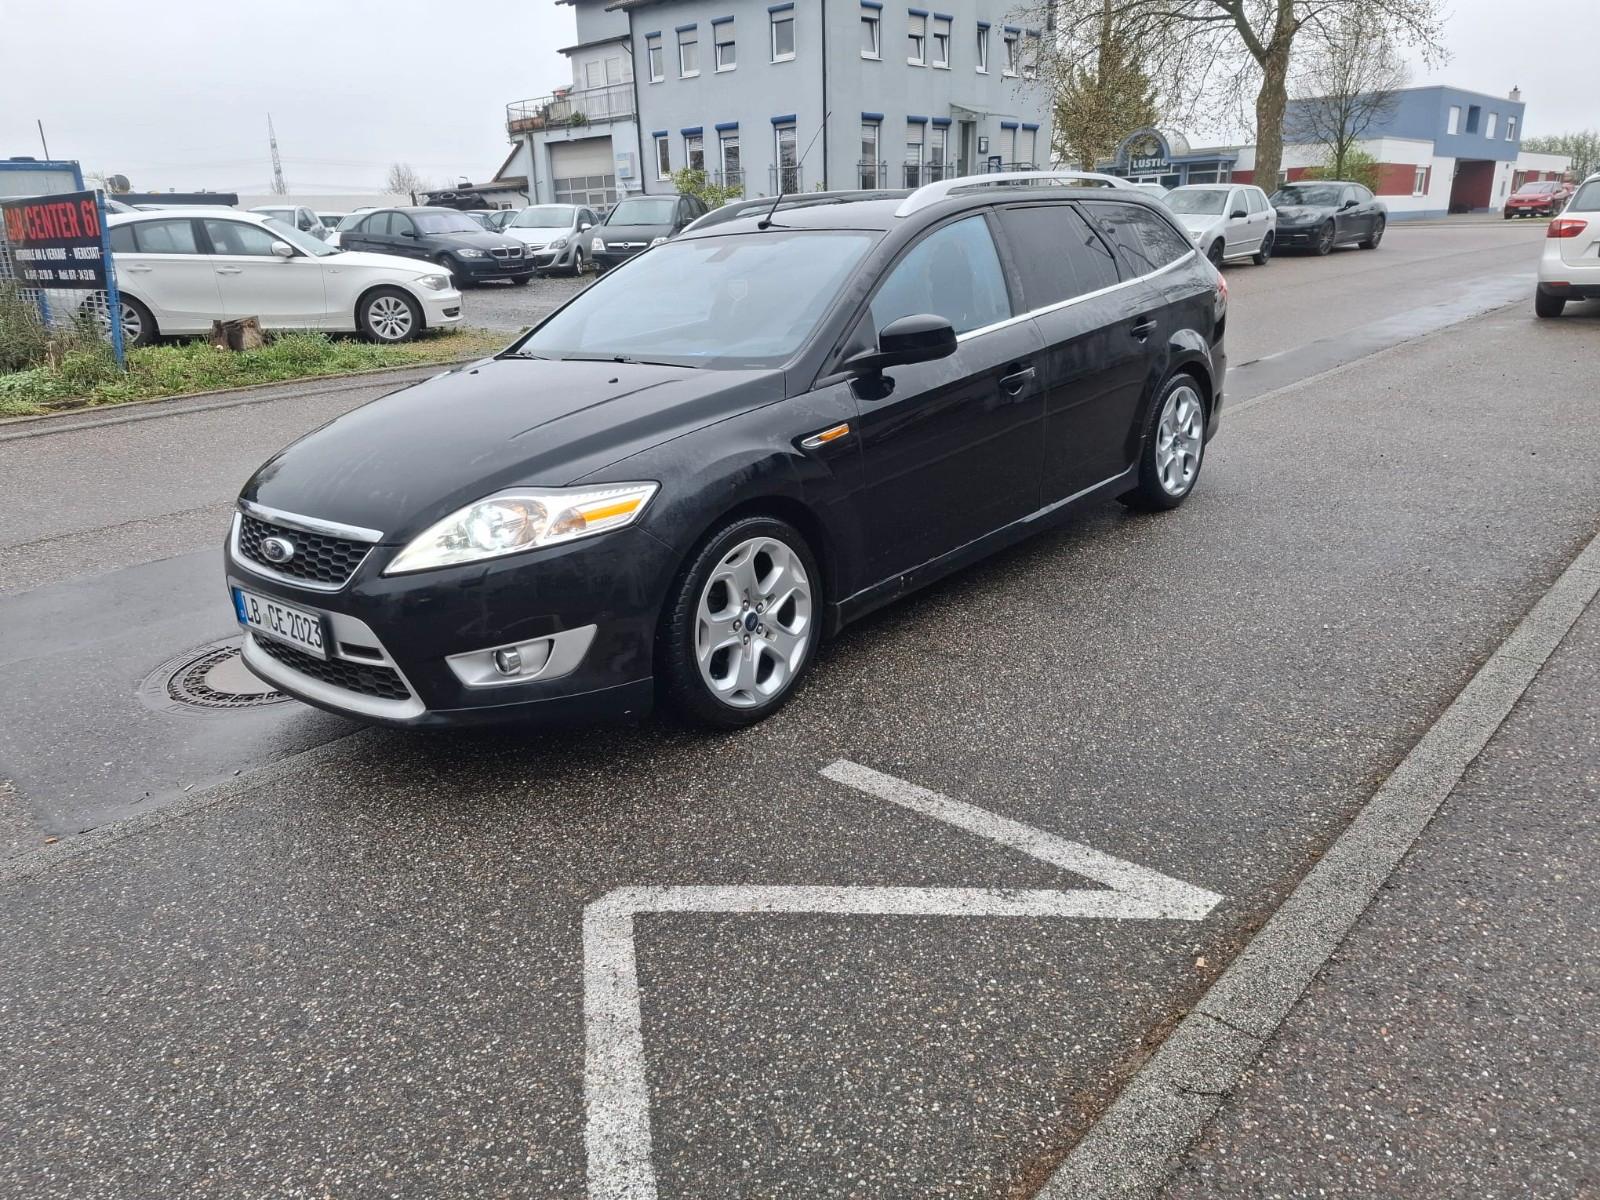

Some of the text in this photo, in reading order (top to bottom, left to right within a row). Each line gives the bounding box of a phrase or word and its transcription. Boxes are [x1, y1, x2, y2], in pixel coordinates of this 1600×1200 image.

[25, 203, 81, 239] CENTER
[81, 200, 100, 237] 61
[243, 594, 322, 648] LB CE 2023
